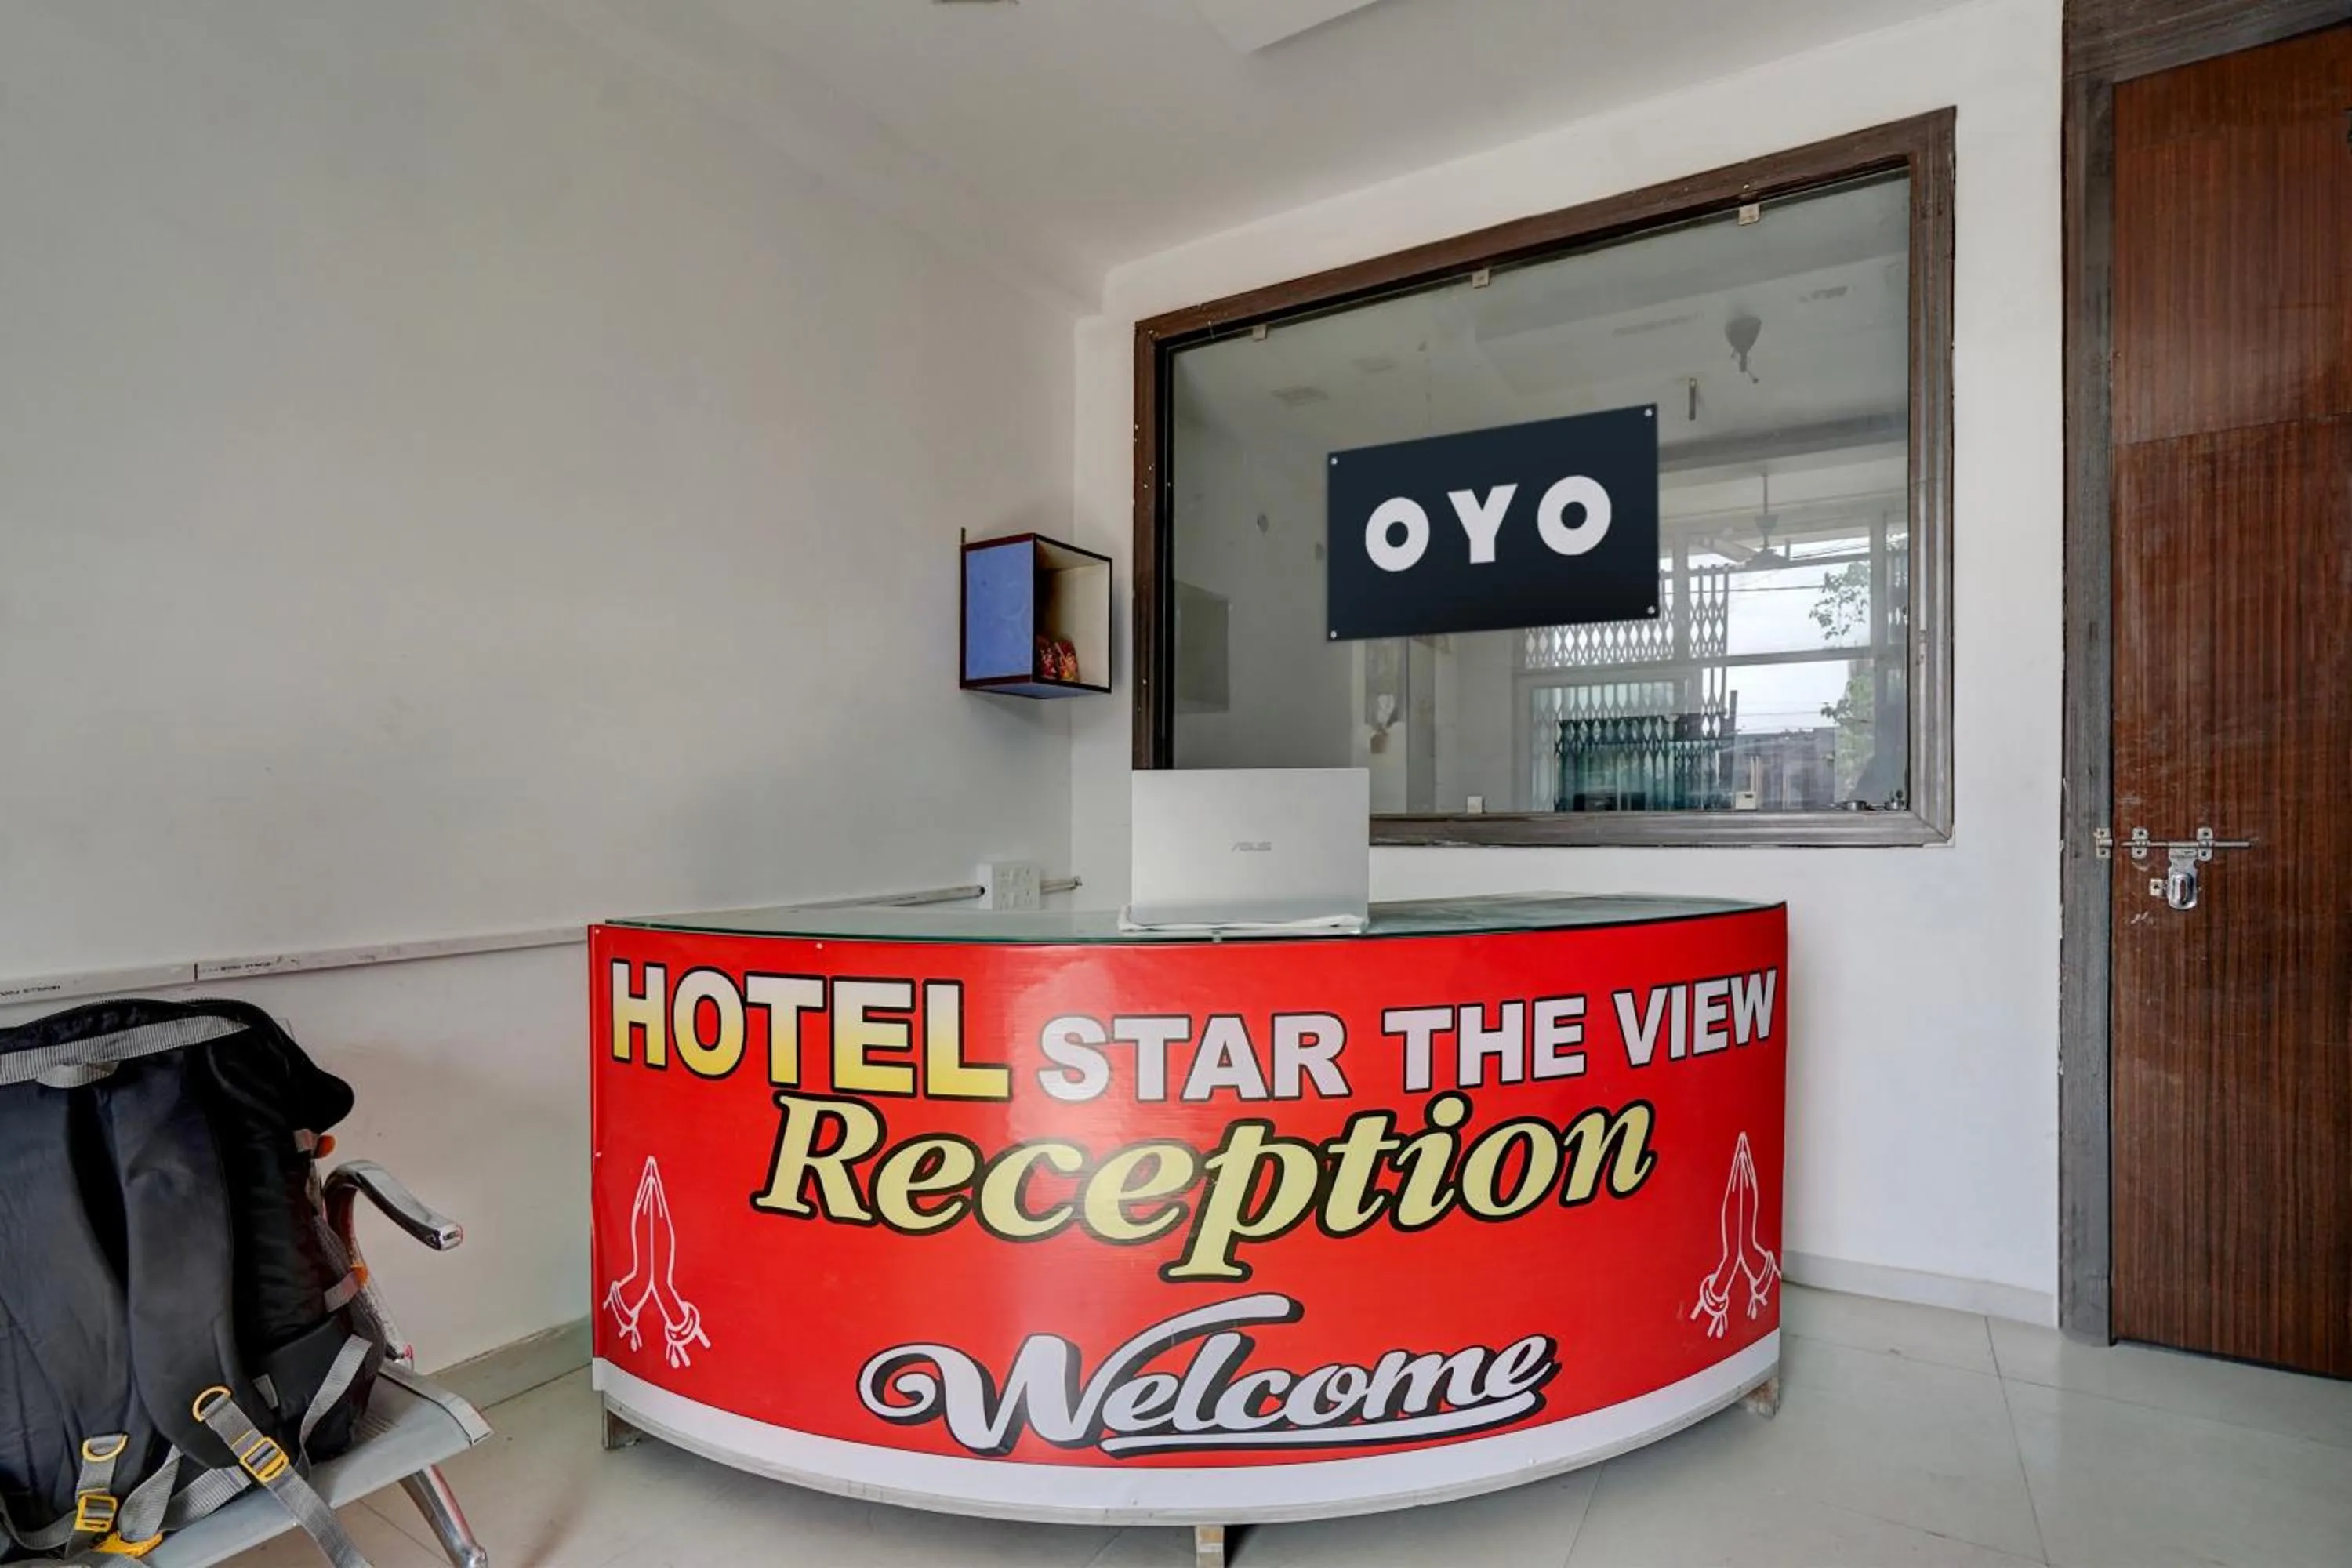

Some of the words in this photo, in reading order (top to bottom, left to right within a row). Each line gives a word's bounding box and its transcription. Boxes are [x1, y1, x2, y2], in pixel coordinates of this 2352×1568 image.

[1365, 475, 1612, 572] OYO
[1230, 841, 1272, 853] ASUS
[611, 958, 1012, 1102] HOTEL
[1037, 1012, 1352, 1102] STAR
[1381, 995, 1587, 1093] THE
[1611, 966, 1779, 1068] VIEW
[750, 1091, 1658, 1283] Reception
[857, 1292, 1562, 1456] Welcome
